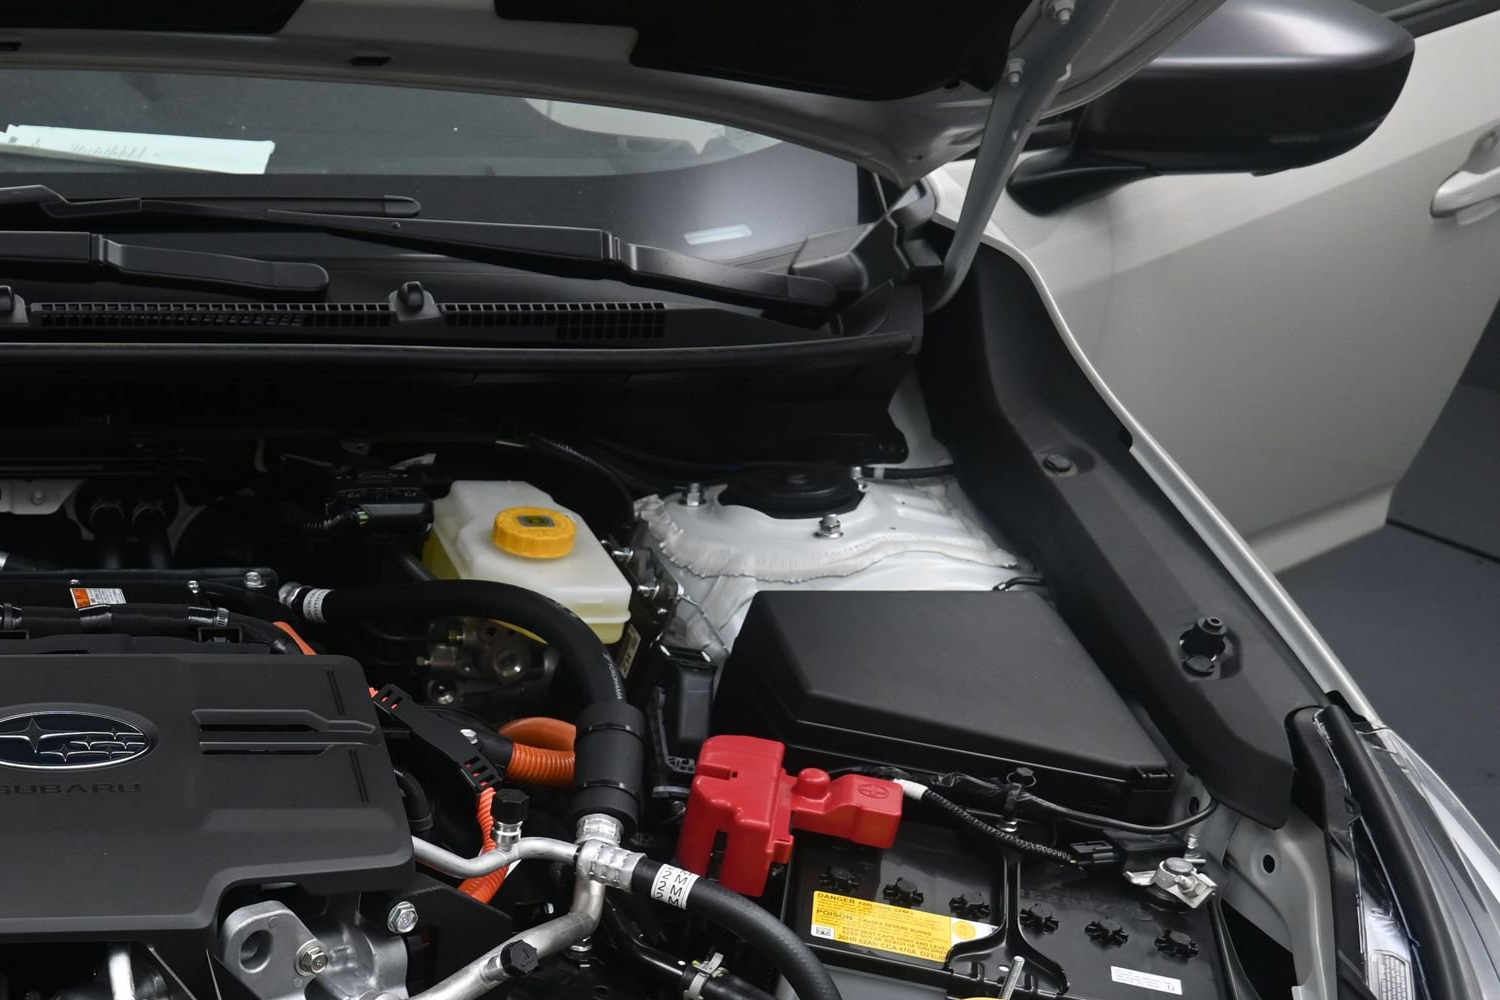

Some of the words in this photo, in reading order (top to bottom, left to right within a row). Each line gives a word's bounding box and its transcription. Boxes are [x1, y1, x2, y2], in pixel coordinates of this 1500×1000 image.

[670, 885, 683, 896] M
[817, 892, 854, 903] DANGER
[816, 908, 852, 920] POISON
